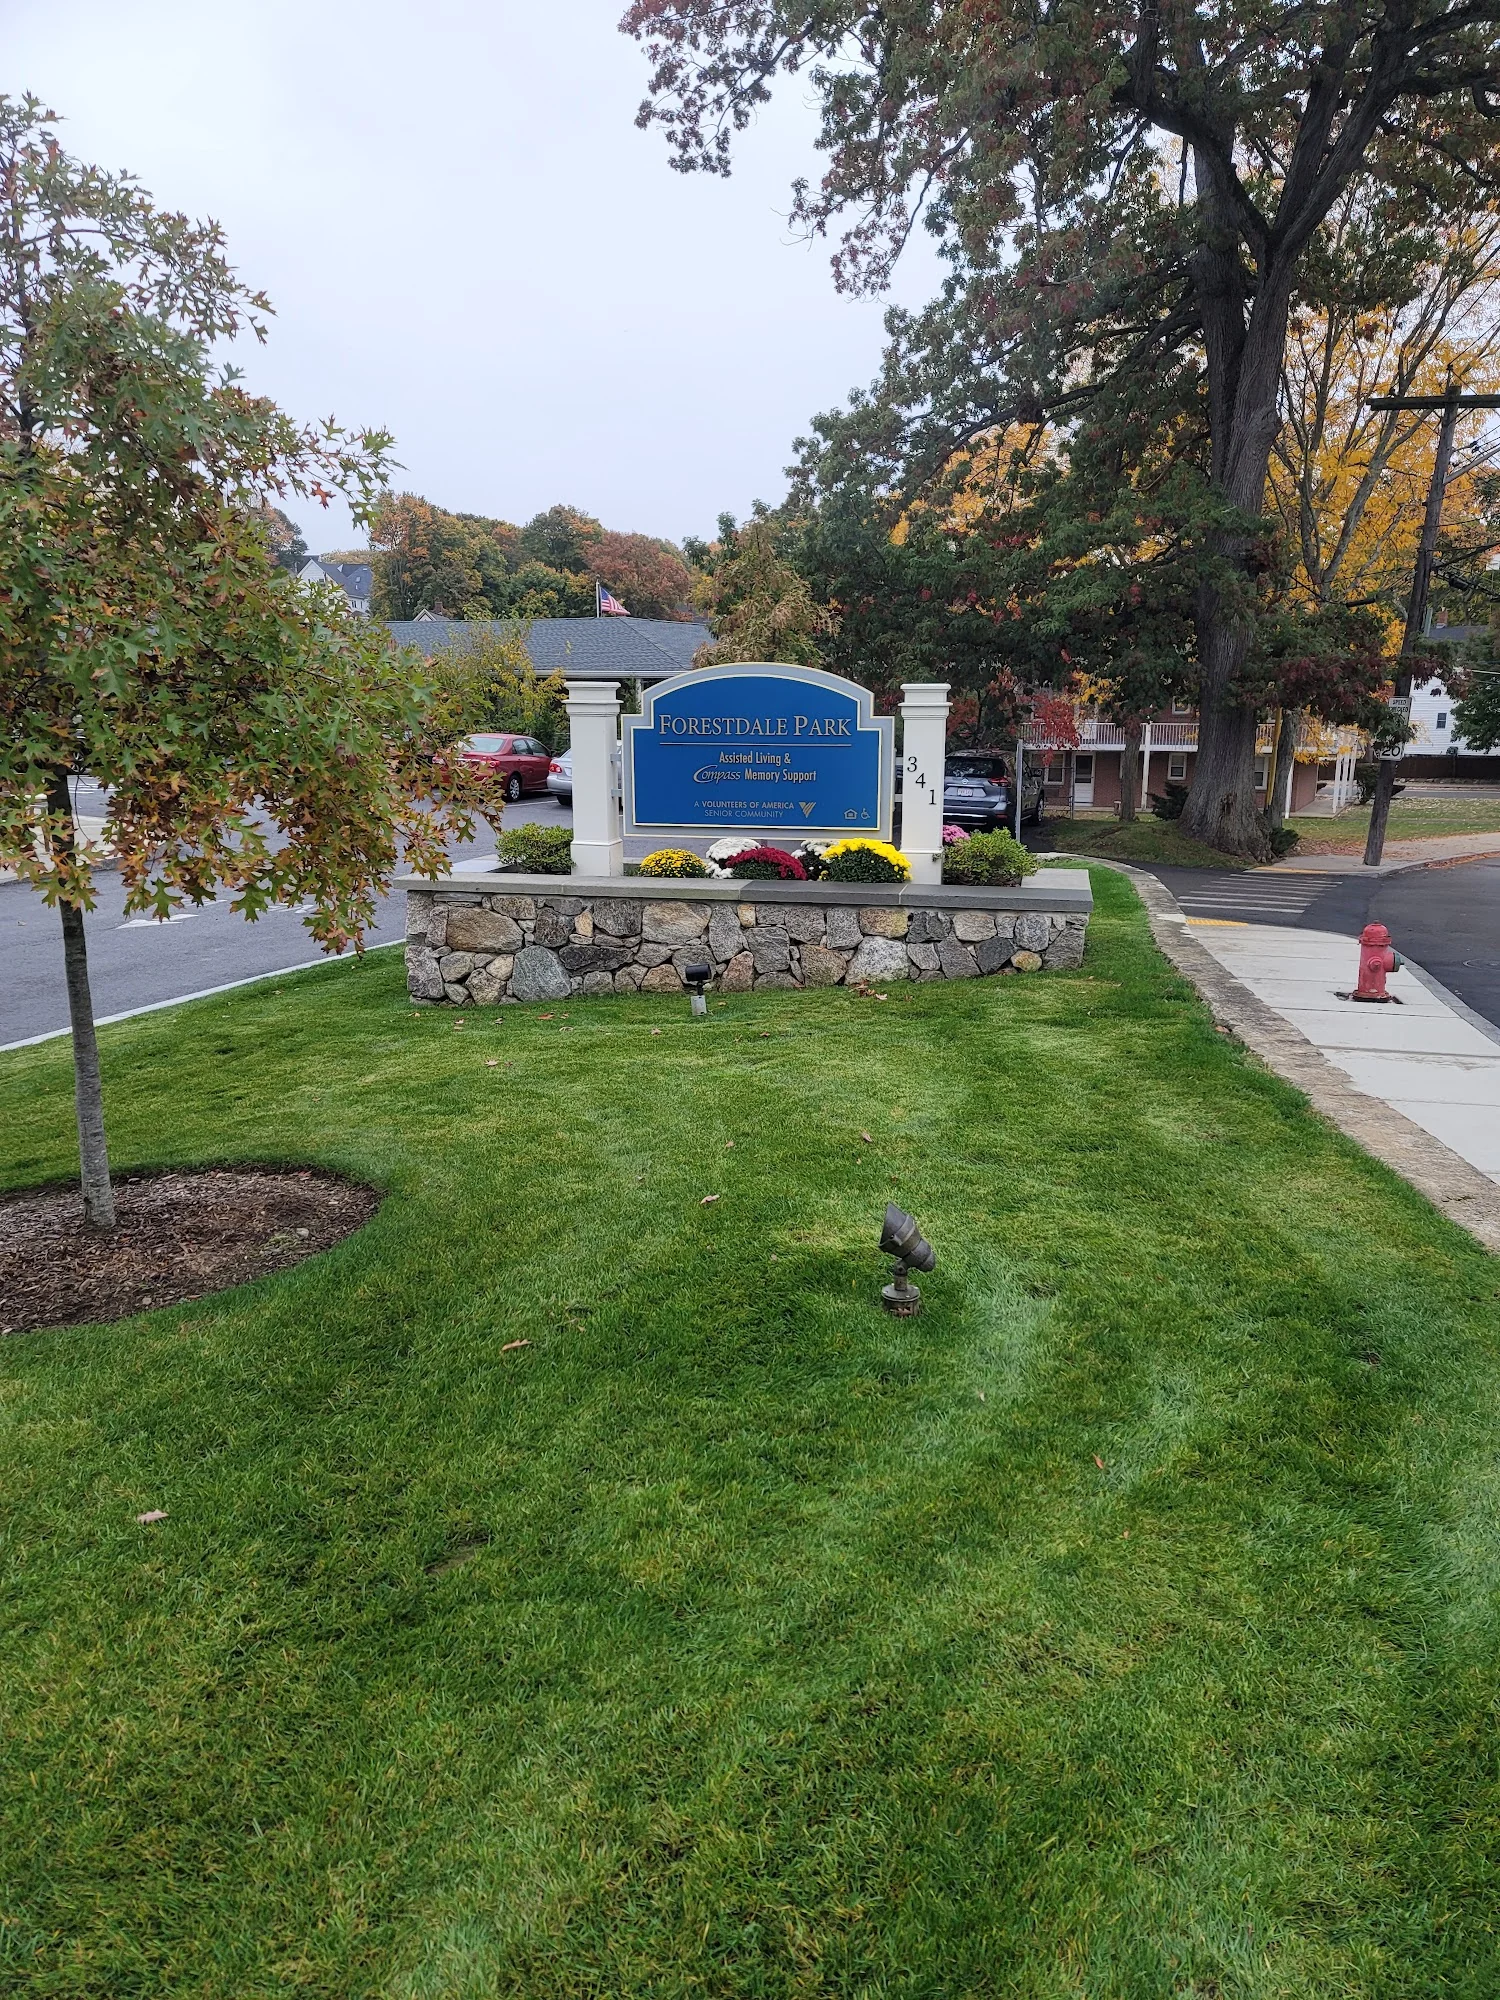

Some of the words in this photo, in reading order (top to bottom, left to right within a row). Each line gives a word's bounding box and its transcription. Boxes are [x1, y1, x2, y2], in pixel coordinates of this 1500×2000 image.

[659, 714, 788, 736] FORESTDALE
[793, 715, 852, 736] PARK
[719, 751, 753, 764] Assisted
[755, 751, 781, 767] Living
[784, 752, 791, 764] &
[693, 764, 741, 784] Compass
[744, 768, 780, 783] Memory
[782, 768, 817, 783] Support
[701, 801, 747, 809] VOLUNTEERS
[749, 801, 760, 809] OF
[761, 801, 794, 809] AMERICA
[704, 809, 733, 817] SENIOR
[735, 810, 784, 818] COMMUNITY
